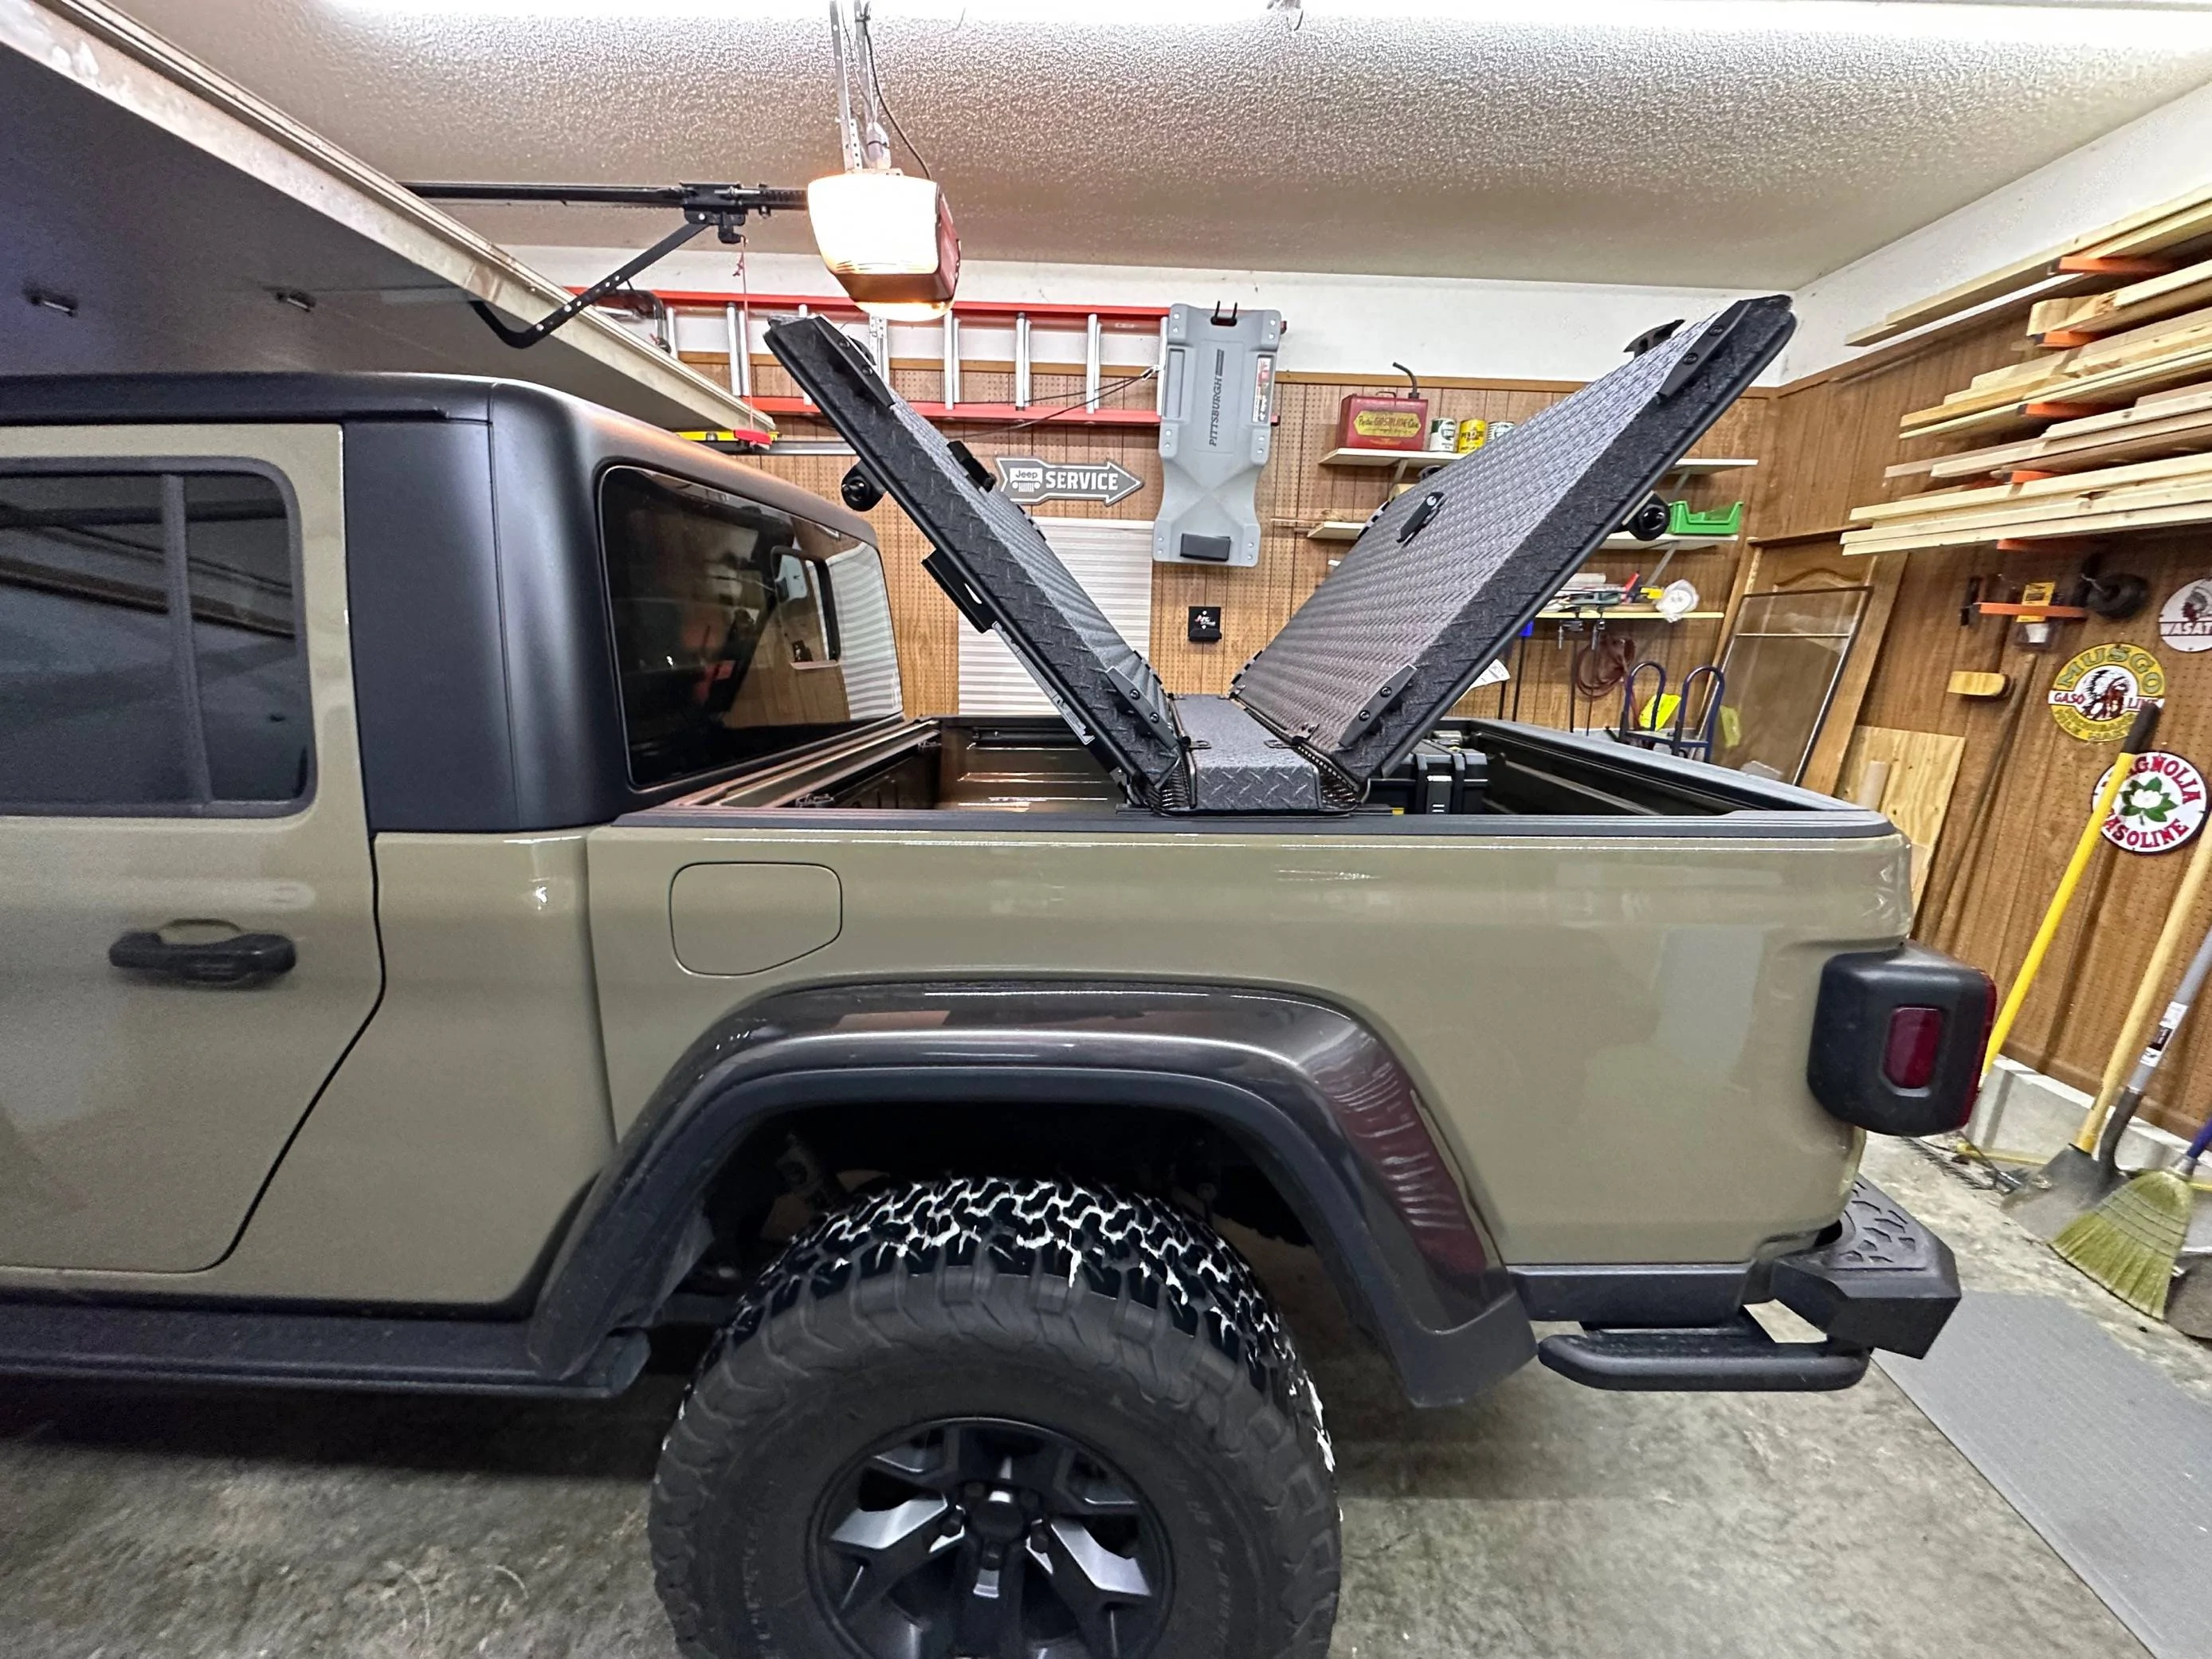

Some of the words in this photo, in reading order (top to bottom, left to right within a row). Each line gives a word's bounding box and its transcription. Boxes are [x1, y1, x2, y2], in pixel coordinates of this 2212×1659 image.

[1209, 377, 1222, 446] PITTSBURGH
[1014, 469, 1038, 480] Jeep
[1045, 471, 1119, 491] SERVICE
[2057, 646, 2163, 694] MUSGO
[2054, 692, 2085, 705] GASO
